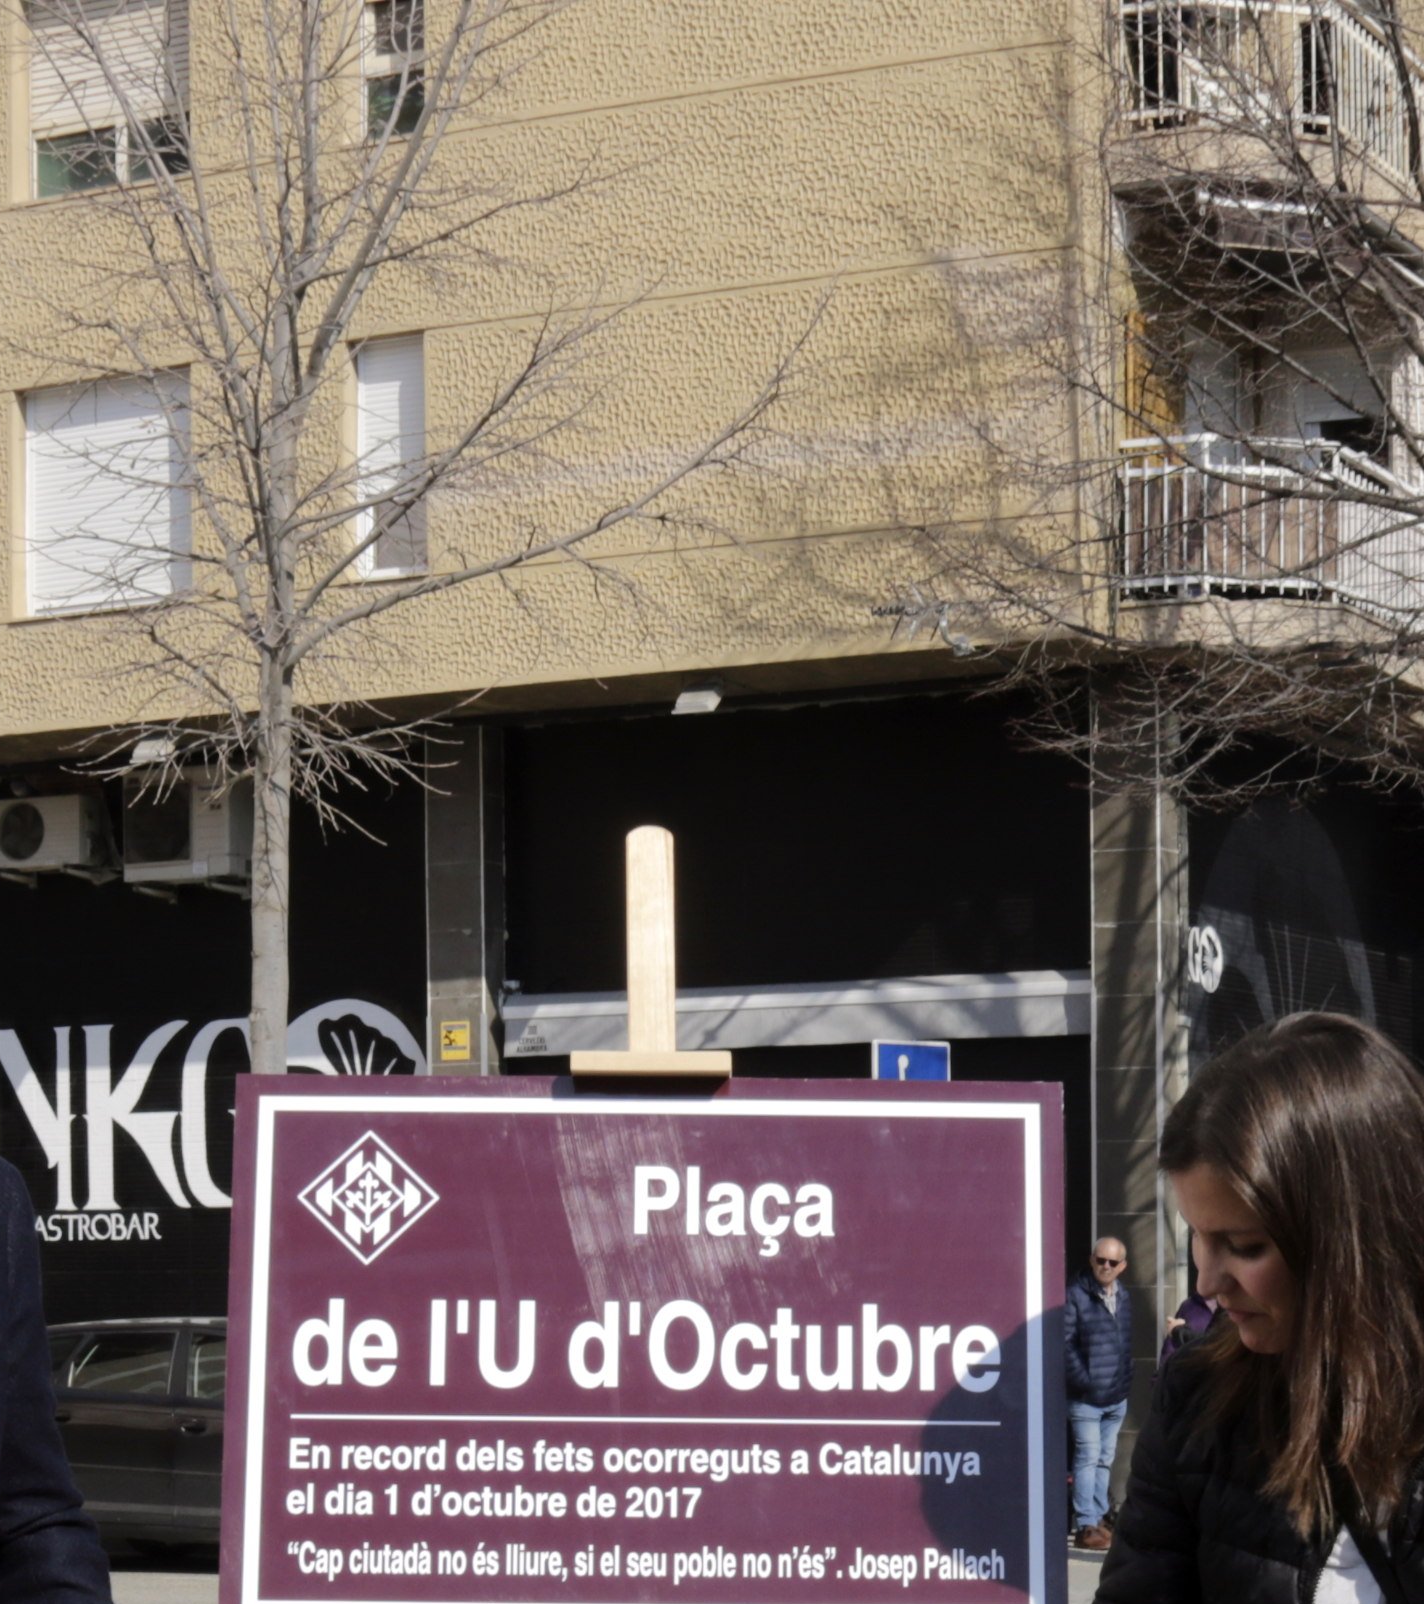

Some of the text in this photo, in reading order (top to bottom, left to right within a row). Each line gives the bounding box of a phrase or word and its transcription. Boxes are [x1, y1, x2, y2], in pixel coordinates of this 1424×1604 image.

[34, 1212, 162, 1241] ASTROBAR
[633, 1165, 835, 1257] Plaça
[292, 1298, 1001, 1392] de l'U d'Octubre
[288, 1437, 981, 1484] En record dels fets ocorreguts a Catalunya
[285, 1482, 703, 1519] el dia 1 d’octubre de 2017
[348, 1541, 432, 1576] ciutadà
[437, 1549, 468, 1576] no
[472, 1541, 500, 1576] és
[505, 1543, 569, 1583] lliure,
[574, 1544, 595, 1577] si
[599, 1544, 621, 1578] el
[626, 1551, 668, 1579] seu
[673, 1545, 737, 1586] poble
[742, 1552, 772, 1579] no
[848, 1547, 918, 1588] Josep
[923, 1547, 1005, 1581] Pallach
